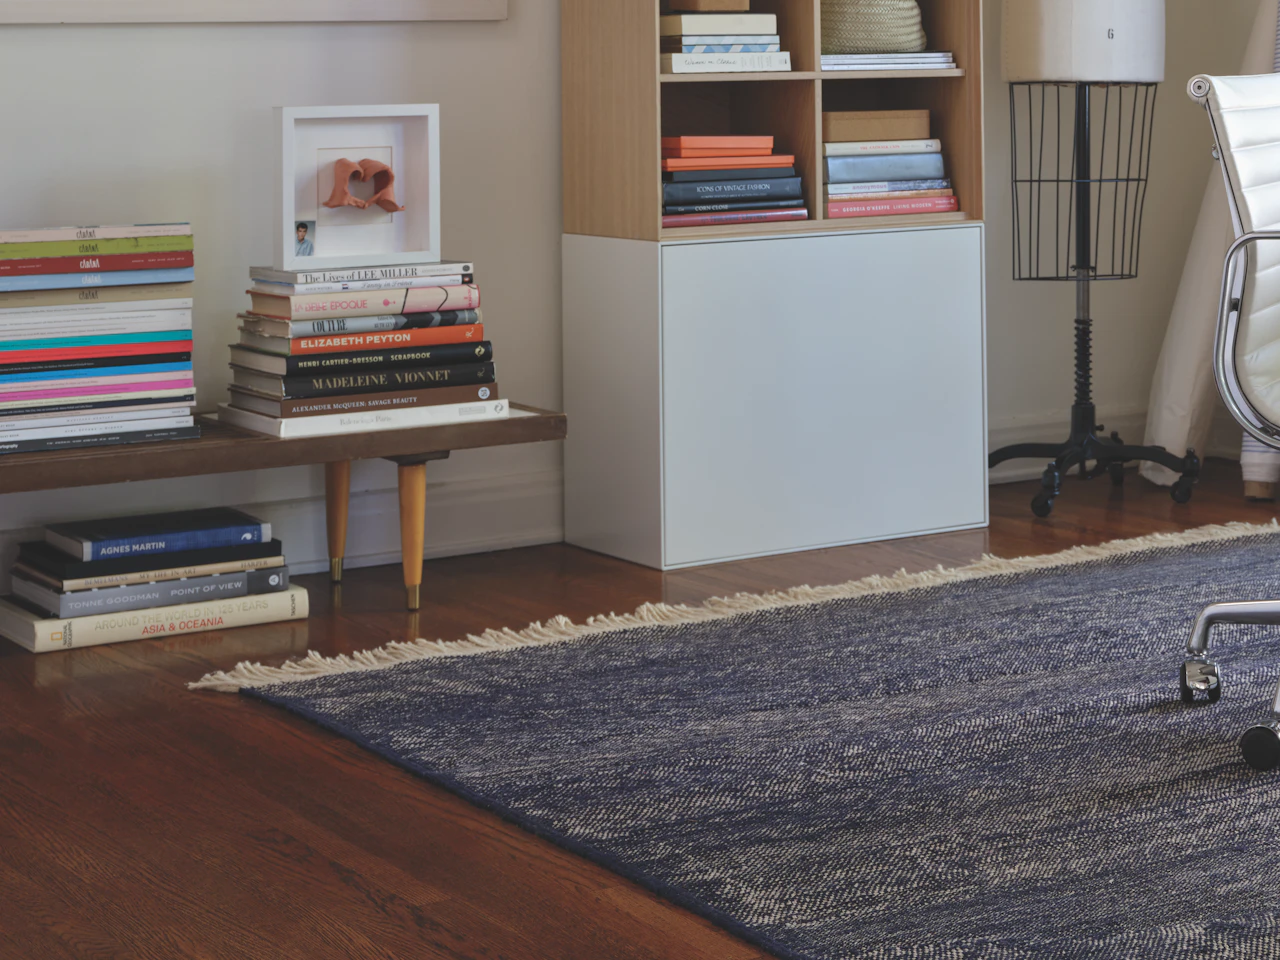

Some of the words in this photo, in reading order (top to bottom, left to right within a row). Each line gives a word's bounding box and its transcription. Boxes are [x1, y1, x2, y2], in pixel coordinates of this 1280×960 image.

[696, 185, 714, 193] ICONS
[724, 184, 746, 192] VINTAGE
[747, 183, 770, 191] FASHION
[852, 183, 887, 191] anonymous
[866, 204, 890, 212] O'KEEFFE
[911, 202, 932, 210] MODERN
[302, 274, 319, 283] The
[323, 271, 345, 283] Lives
[346, 270, 355, 281] of
[357, 269, 378, 280] LEE
[379, 267, 417, 279] MILLER
[312, 319, 348, 333] COUTURE
[301, 336, 364, 348] ELIZABETH
[366, 333, 411, 344] PEYTON
[298, 360, 320, 368] HENRI
[321, 355, 384, 367] CARTIER-BRESSON
[390, 352, 431, 361] SCRAPBOOK
[312, 374, 388, 390] MADELEINE
[395, 369, 451, 384] VIONNET
[292, 404, 332, 413] ALEXANDER
[367, 398, 391, 407] SAVAGE
[392, 396, 418, 405] BEAUTY
[100, 543, 131, 556] AGNES
[132, 541, 166, 552] MARTIN
[84, 575, 129, 586] BEMELMANS
[240, 560, 268, 569] HARPER
[68, 598, 104, 609] TONNE
[106, 592, 160, 605] GOODMAN
[170, 586, 201, 597] POINT
[202, 584, 217, 593] OF
[218, 581, 243, 591] VIEW
[94, 613, 139, 631] AROUND
[141, 610, 163, 623] THE
[165, 607, 201, 621] WORLD
[204, 605, 215, 616] IN
[236, 599, 269, 612] YEARS
[141, 623, 166, 635] ASIA
[168, 622, 176, 632] &
[178, 616, 224, 631] OCEANIA
